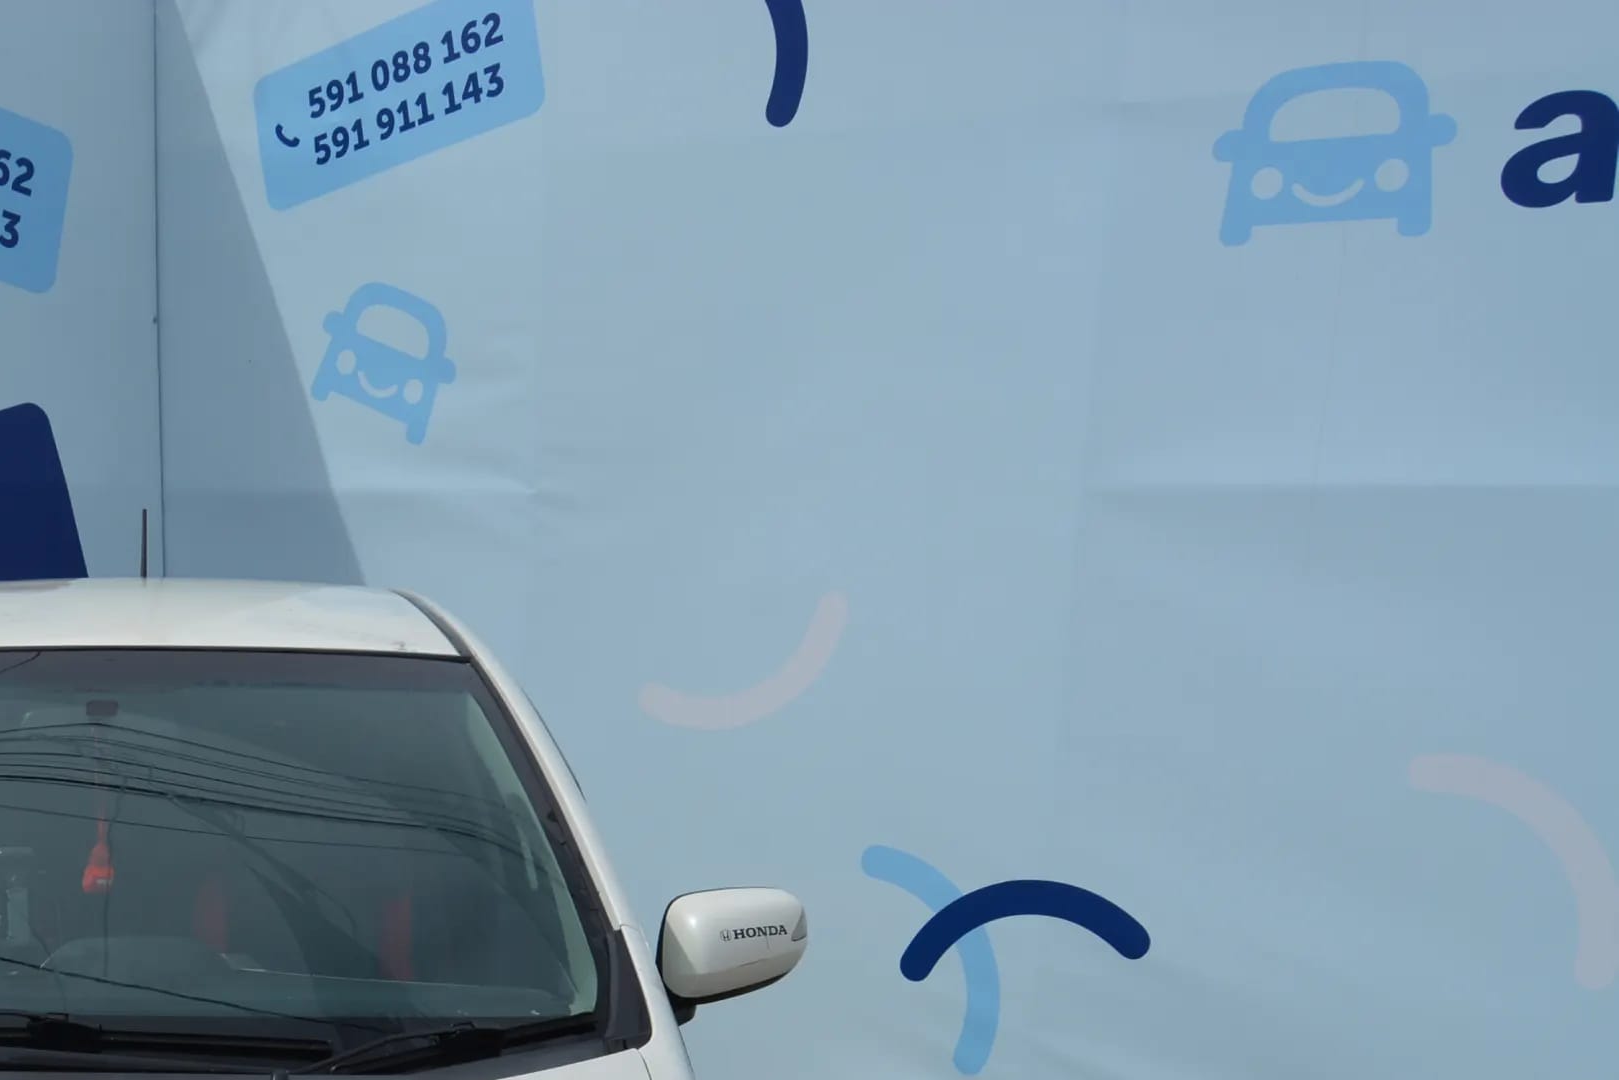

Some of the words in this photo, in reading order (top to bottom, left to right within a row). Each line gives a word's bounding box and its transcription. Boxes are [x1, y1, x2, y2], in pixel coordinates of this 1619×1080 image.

[308, 71, 364, 119] 591
[370, 41, 432, 92] 088
[440, 12, 504, 65] 162
[314, 118, 370, 166] 591
[376, 92, 435, 141] 911
[441, 62, 504, 115] 143
[1500, 89, 1619, 208] a
[733, 924, 788, 940] HONDA
